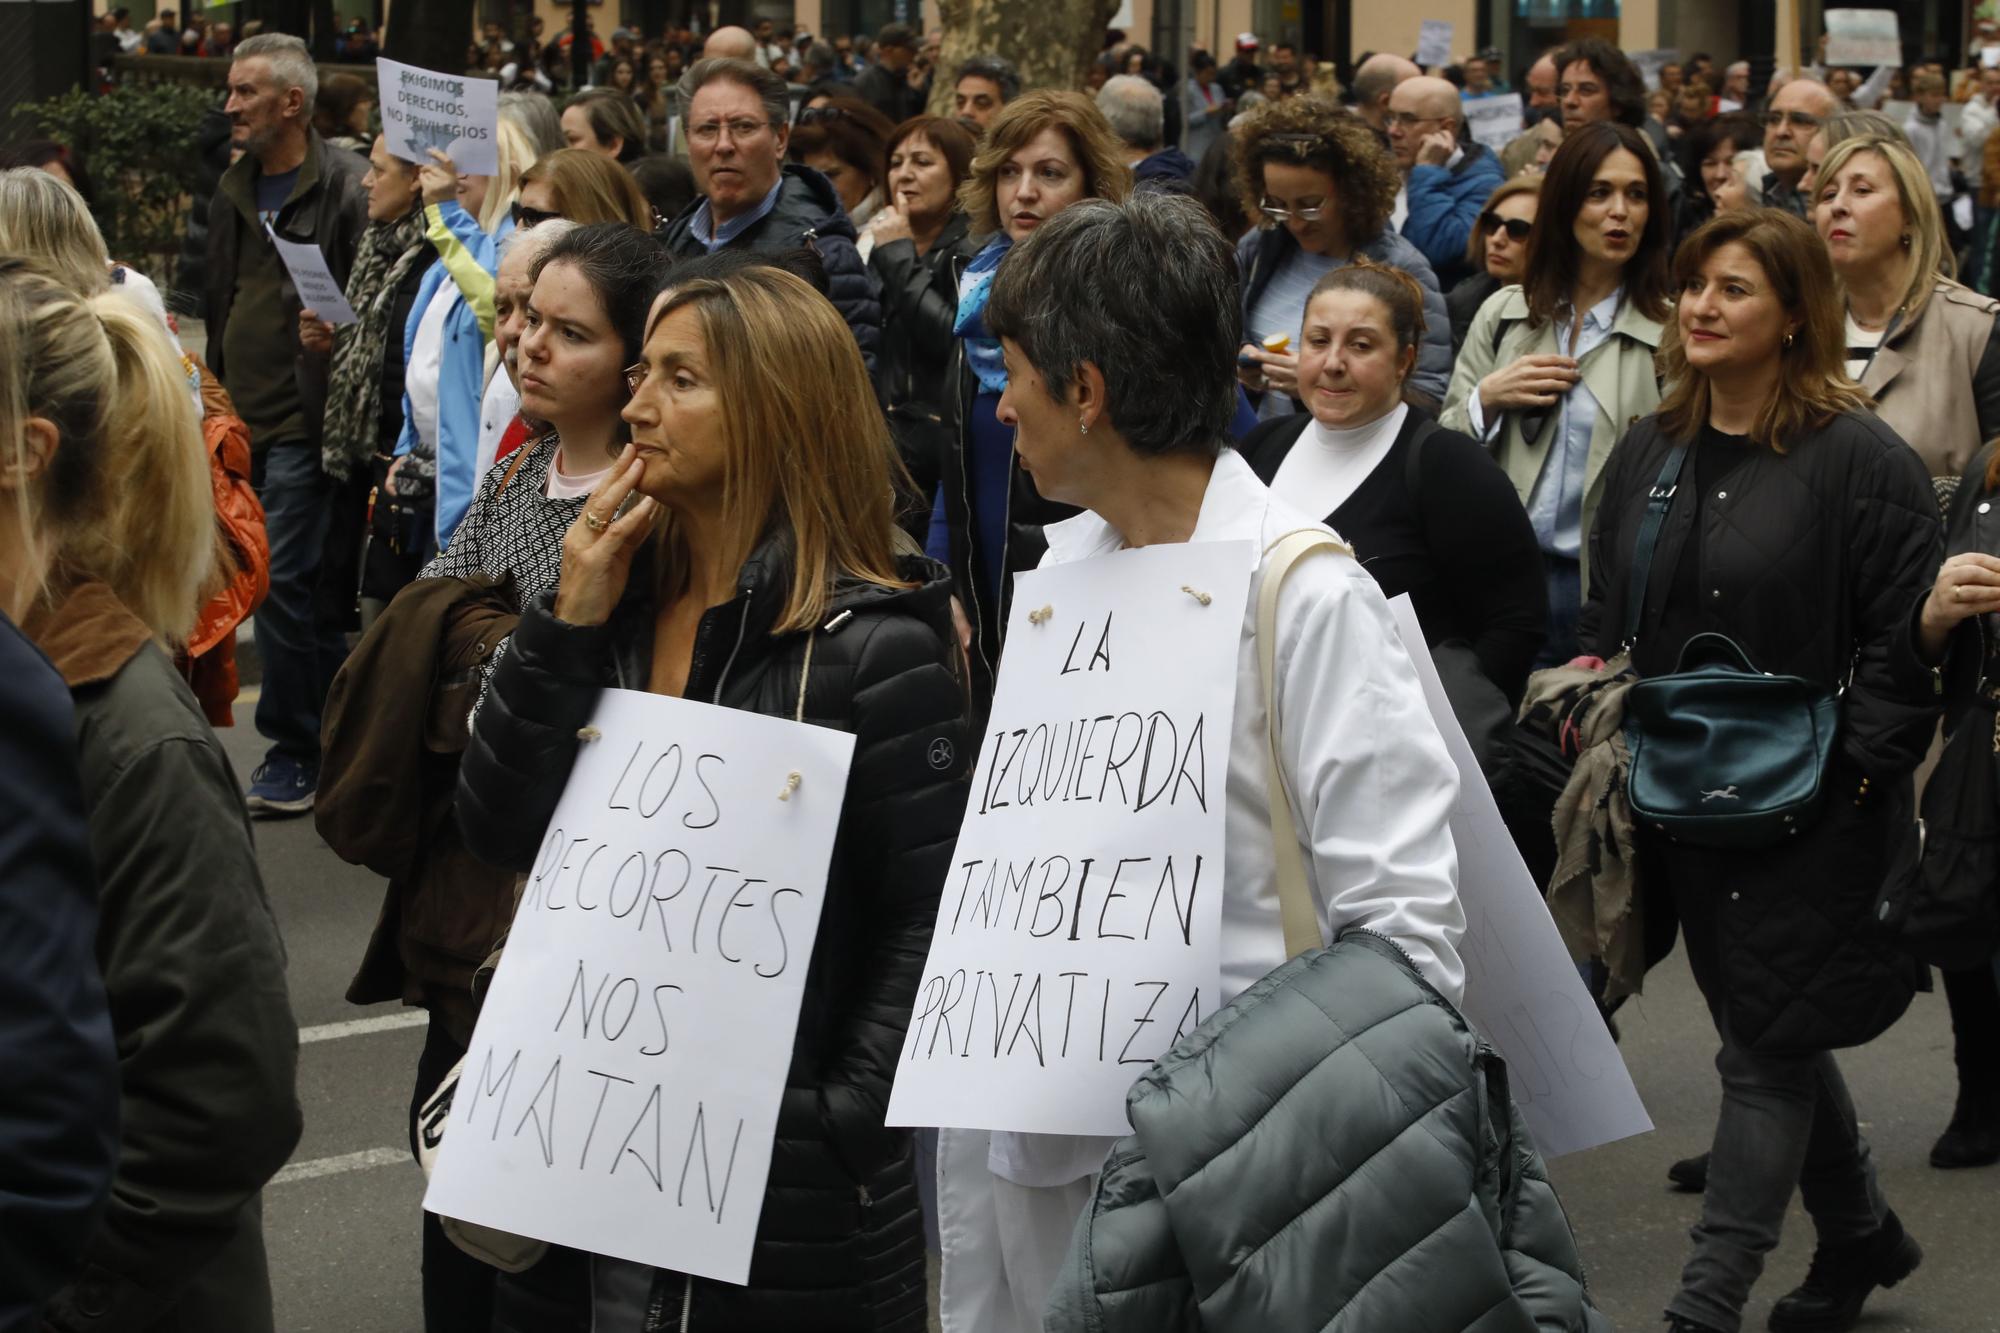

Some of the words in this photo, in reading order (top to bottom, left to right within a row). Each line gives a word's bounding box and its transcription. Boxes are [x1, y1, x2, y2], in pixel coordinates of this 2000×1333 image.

[387, 106, 403, 122] NO
[406, 114, 488, 139] PRIVILEGIOS
[398, 90, 468, 118] DERECHOS,
[400, 71, 465, 97] EXIGIMOS
[1060, 611, 1112, 674] LA
[609, 741, 725, 828] LOS
[979, 711, 1206, 814] IZQUIERDA
[528, 829, 803, 977] RECORTES
[952, 855, 1202, 945] TAMBIEN
[555, 960, 683, 1055] NOS
[911, 968, 1199, 1067] PRIVATIZA
[467, 1044, 743, 1224] MATAN
